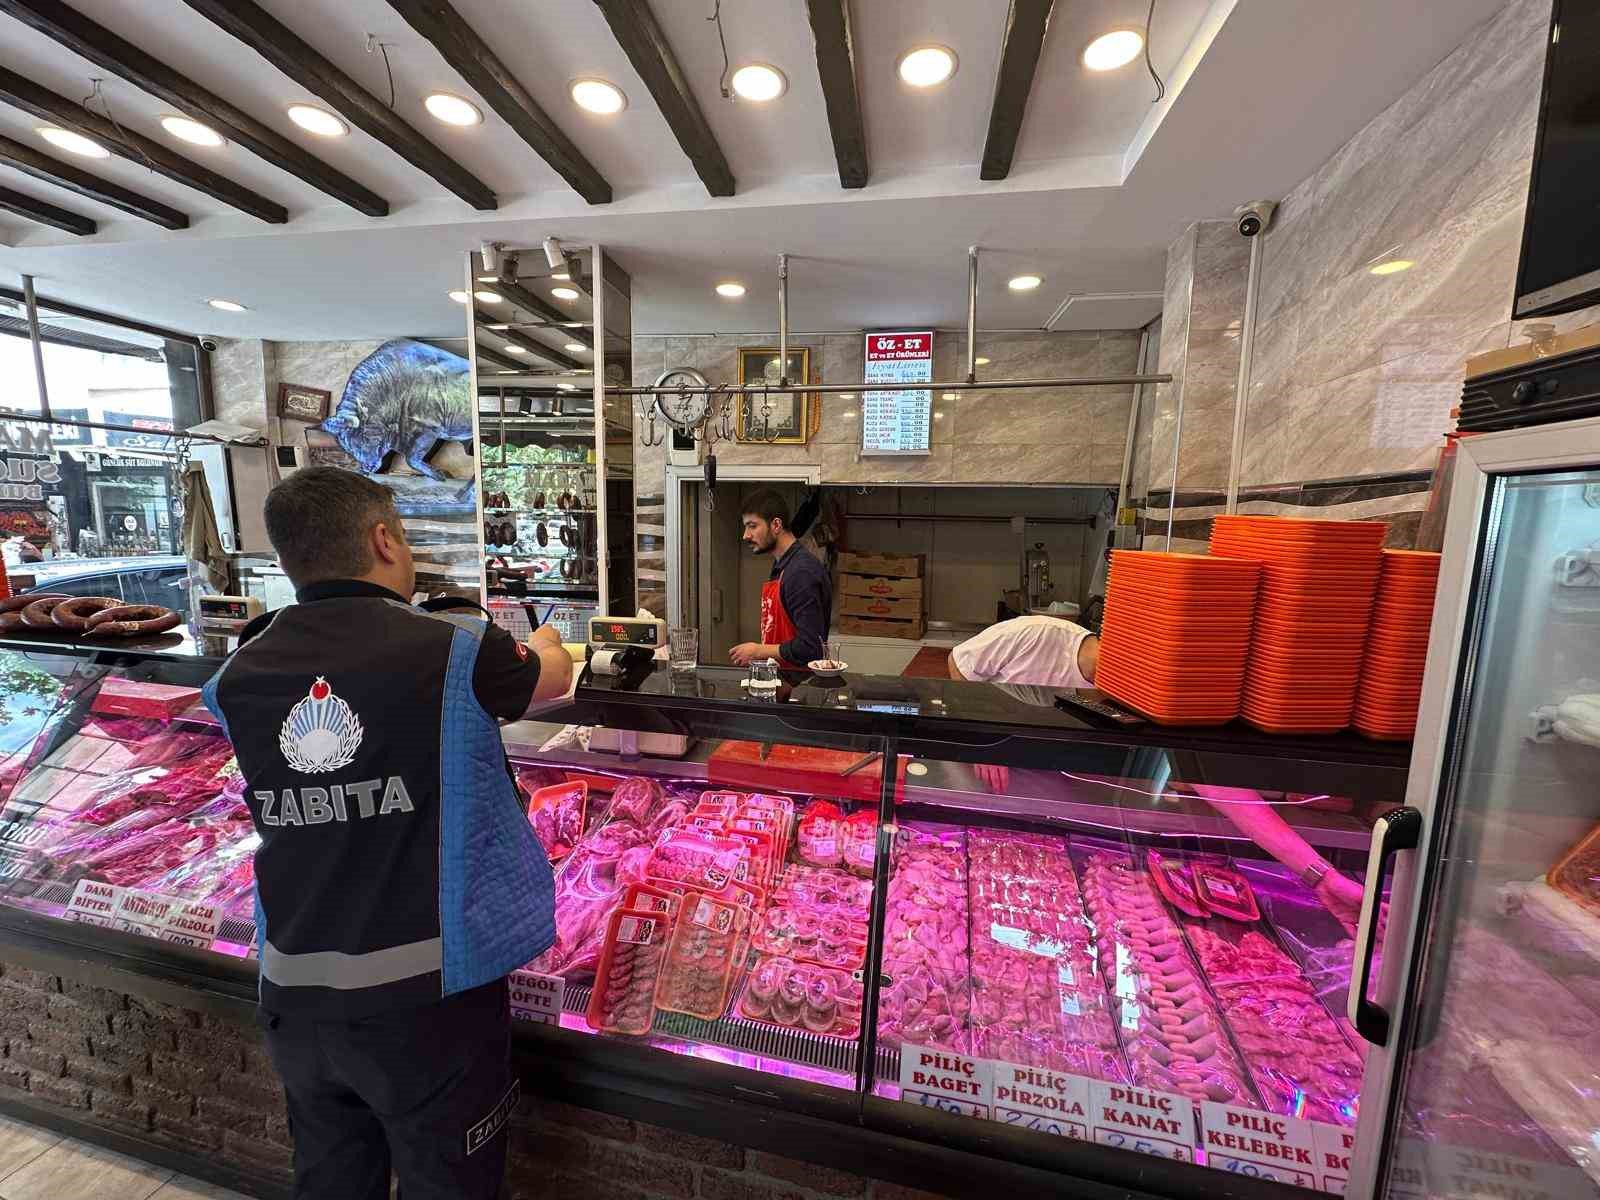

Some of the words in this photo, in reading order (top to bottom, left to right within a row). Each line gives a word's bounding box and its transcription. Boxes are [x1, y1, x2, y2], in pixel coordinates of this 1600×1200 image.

[877, 337, 896, 350] ÖZ
[904, 338, 922, 349] ET
[254, 776, 415, 827] ZABITA
[84, 884, 114, 898] DANA
[919, 1052, 975, 1078] PİLİÇ
[912, 1071, 982, 1096] BAGET
[1013, 1068, 1067, 1095] PİLİÇ
[996, 1085, 1085, 1117] PİRZOLA
[1110, 1086, 1172, 1116] PİLİÇ
[1102, 1106, 1182, 1136] KANAT
[1226, 1111, 1287, 1143] PİLİÇ
[1207, 1129, 1313, 1165] KELEBEK
